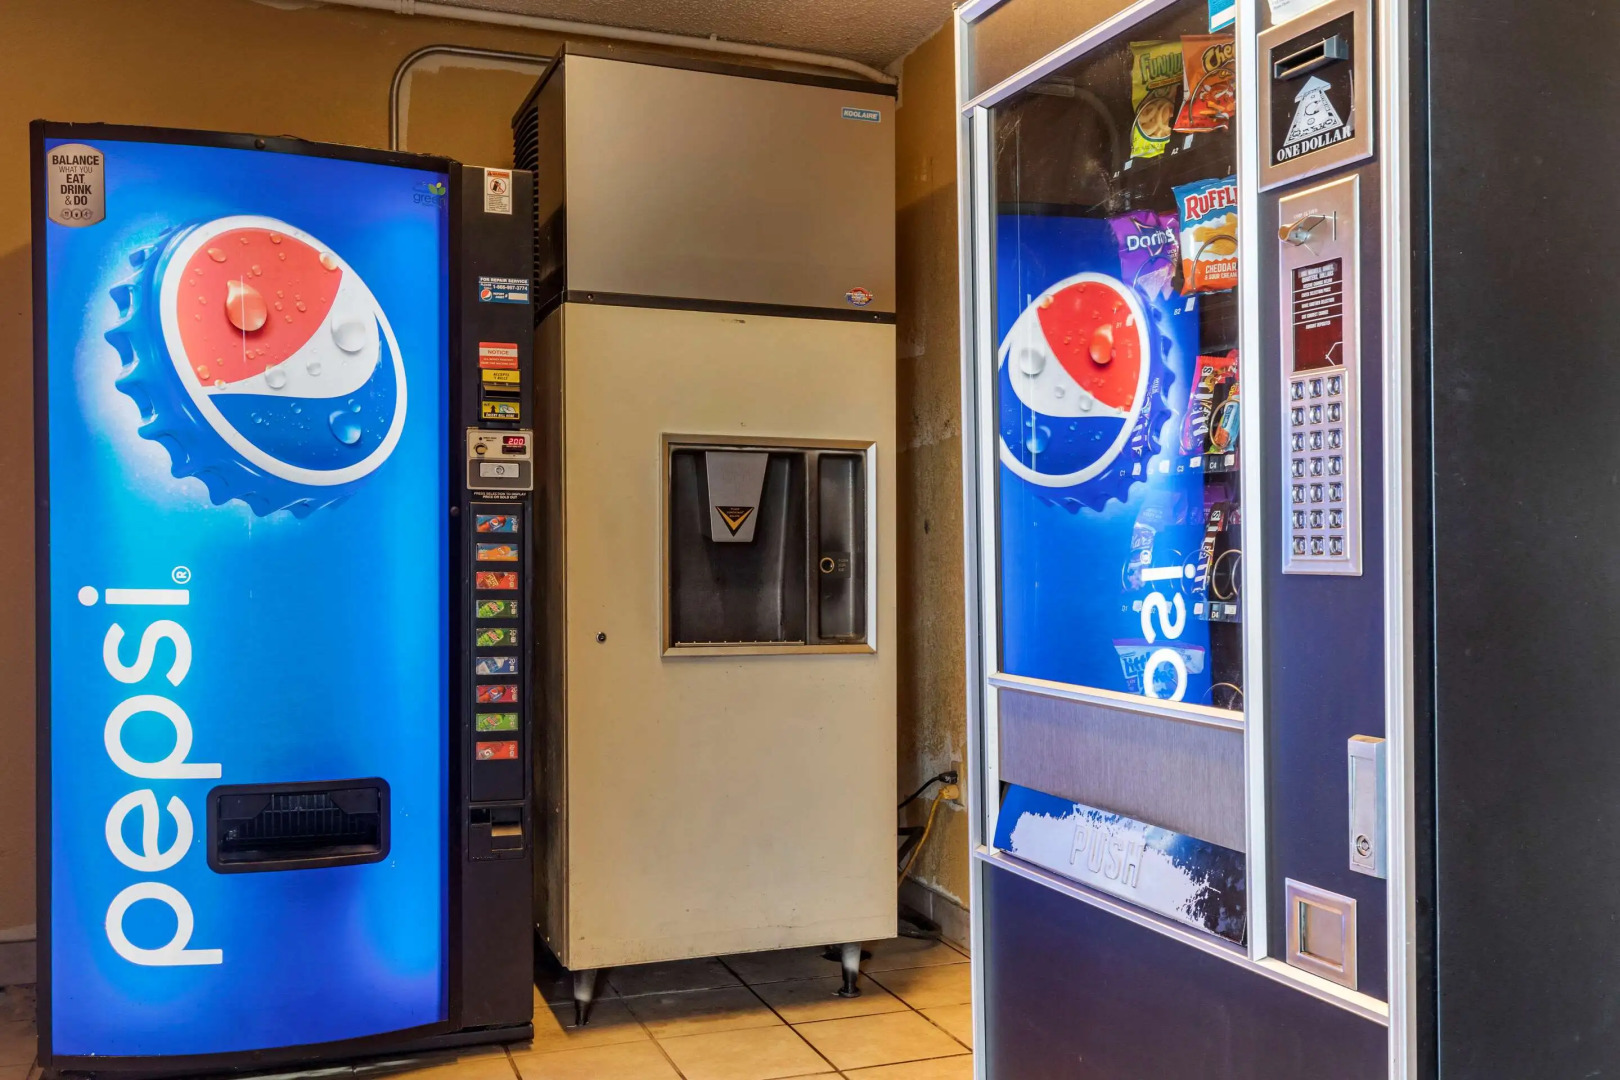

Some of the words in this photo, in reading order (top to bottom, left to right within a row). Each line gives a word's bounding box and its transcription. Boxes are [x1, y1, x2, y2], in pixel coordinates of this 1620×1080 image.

[844, 110, 878, 119] KOOLAIRE
[1276, 146, 1300, 162] ONE
[1300, 125, 1352, 155] DOLLAR
[52, 155, 99, 165] BALANCE
[61, 185, 92, 194] DRINK
[65, 195, 72, 205] &
[74, 196, 87, 205] DO
[413, 193, 446, 204] green
[1205, 262, 1237, 273] CHEDDAR
[1069, 824, 1146, 889] PUSH
